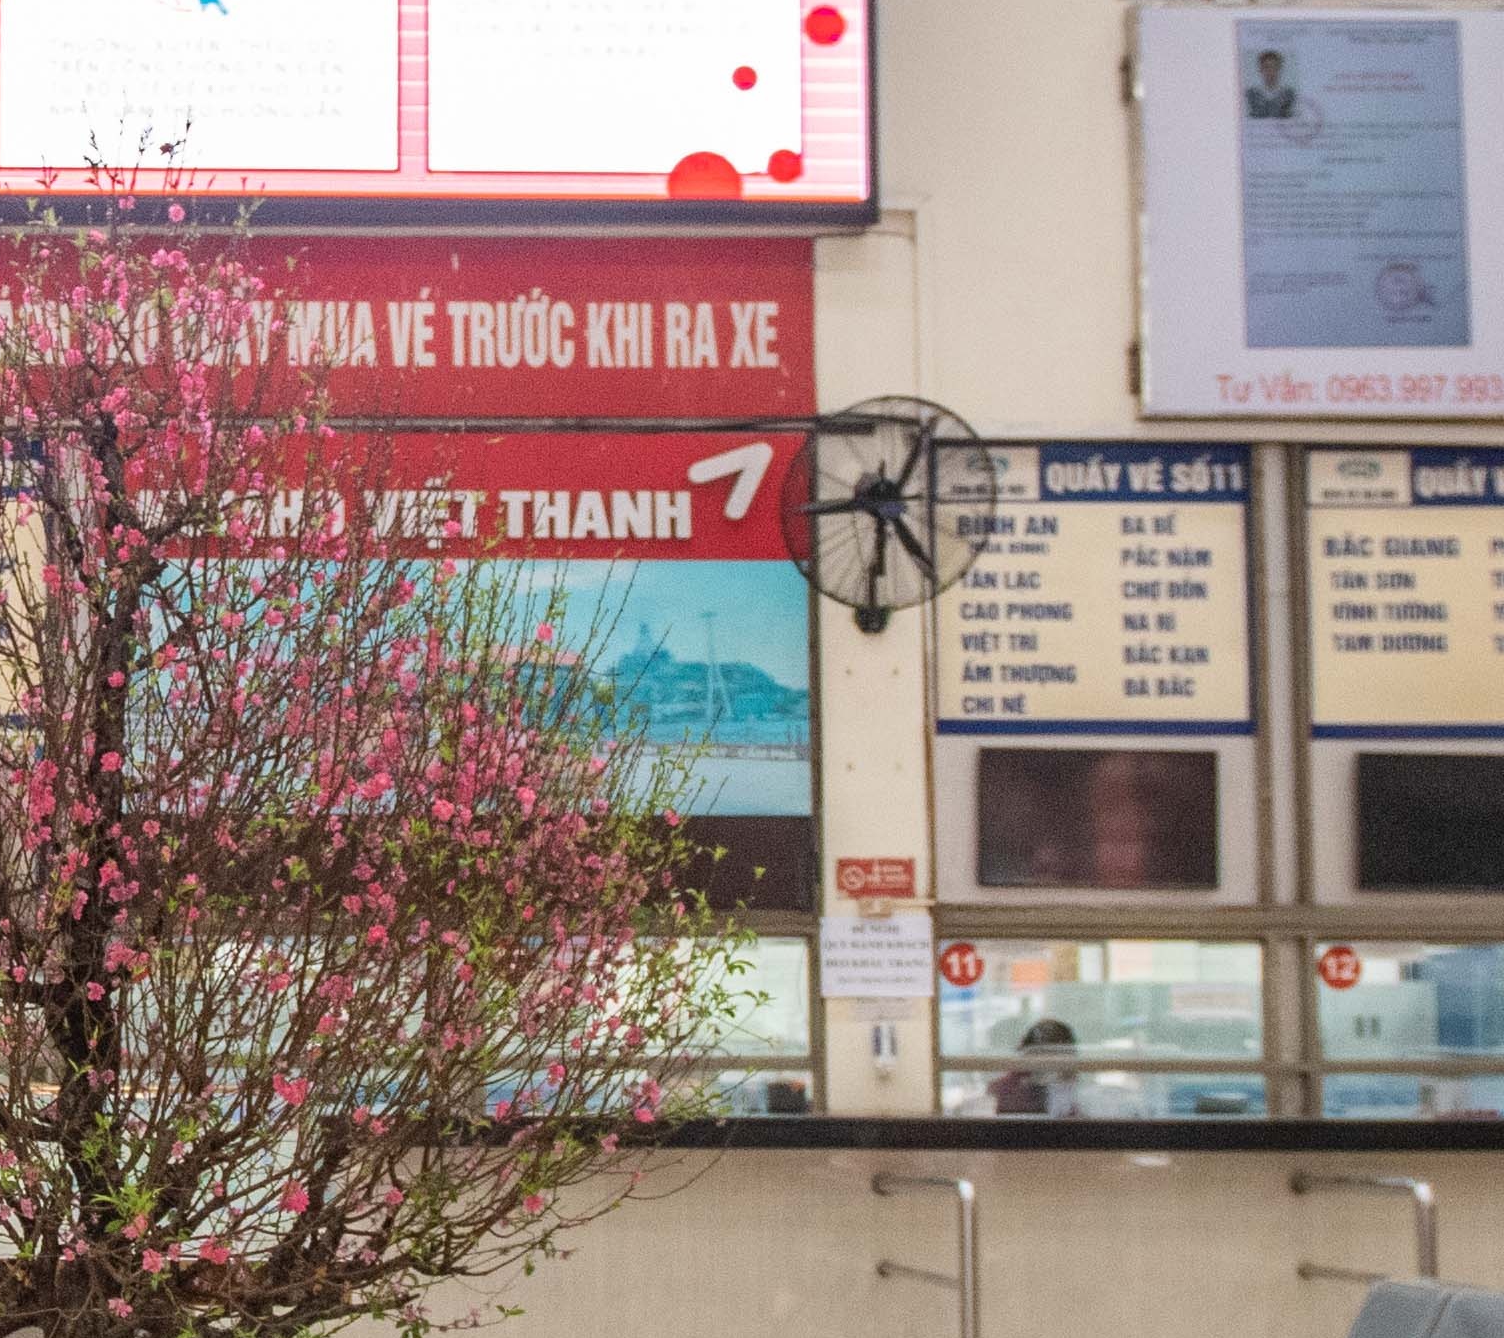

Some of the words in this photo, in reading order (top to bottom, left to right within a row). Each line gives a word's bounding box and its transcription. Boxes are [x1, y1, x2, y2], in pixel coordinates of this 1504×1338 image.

[288, 300, 377, 367] MUA
[387, 287, 436, 368] VÉ
[447, 287, 576, 369] TRƯỚC
[586, 301, 654, 369] KHI
[666, 301, 718, 369] RA
[732, 300, 780, 369] XE
[503, 490, 692, 541] THANH
[949, 950, 977, 978] 11
